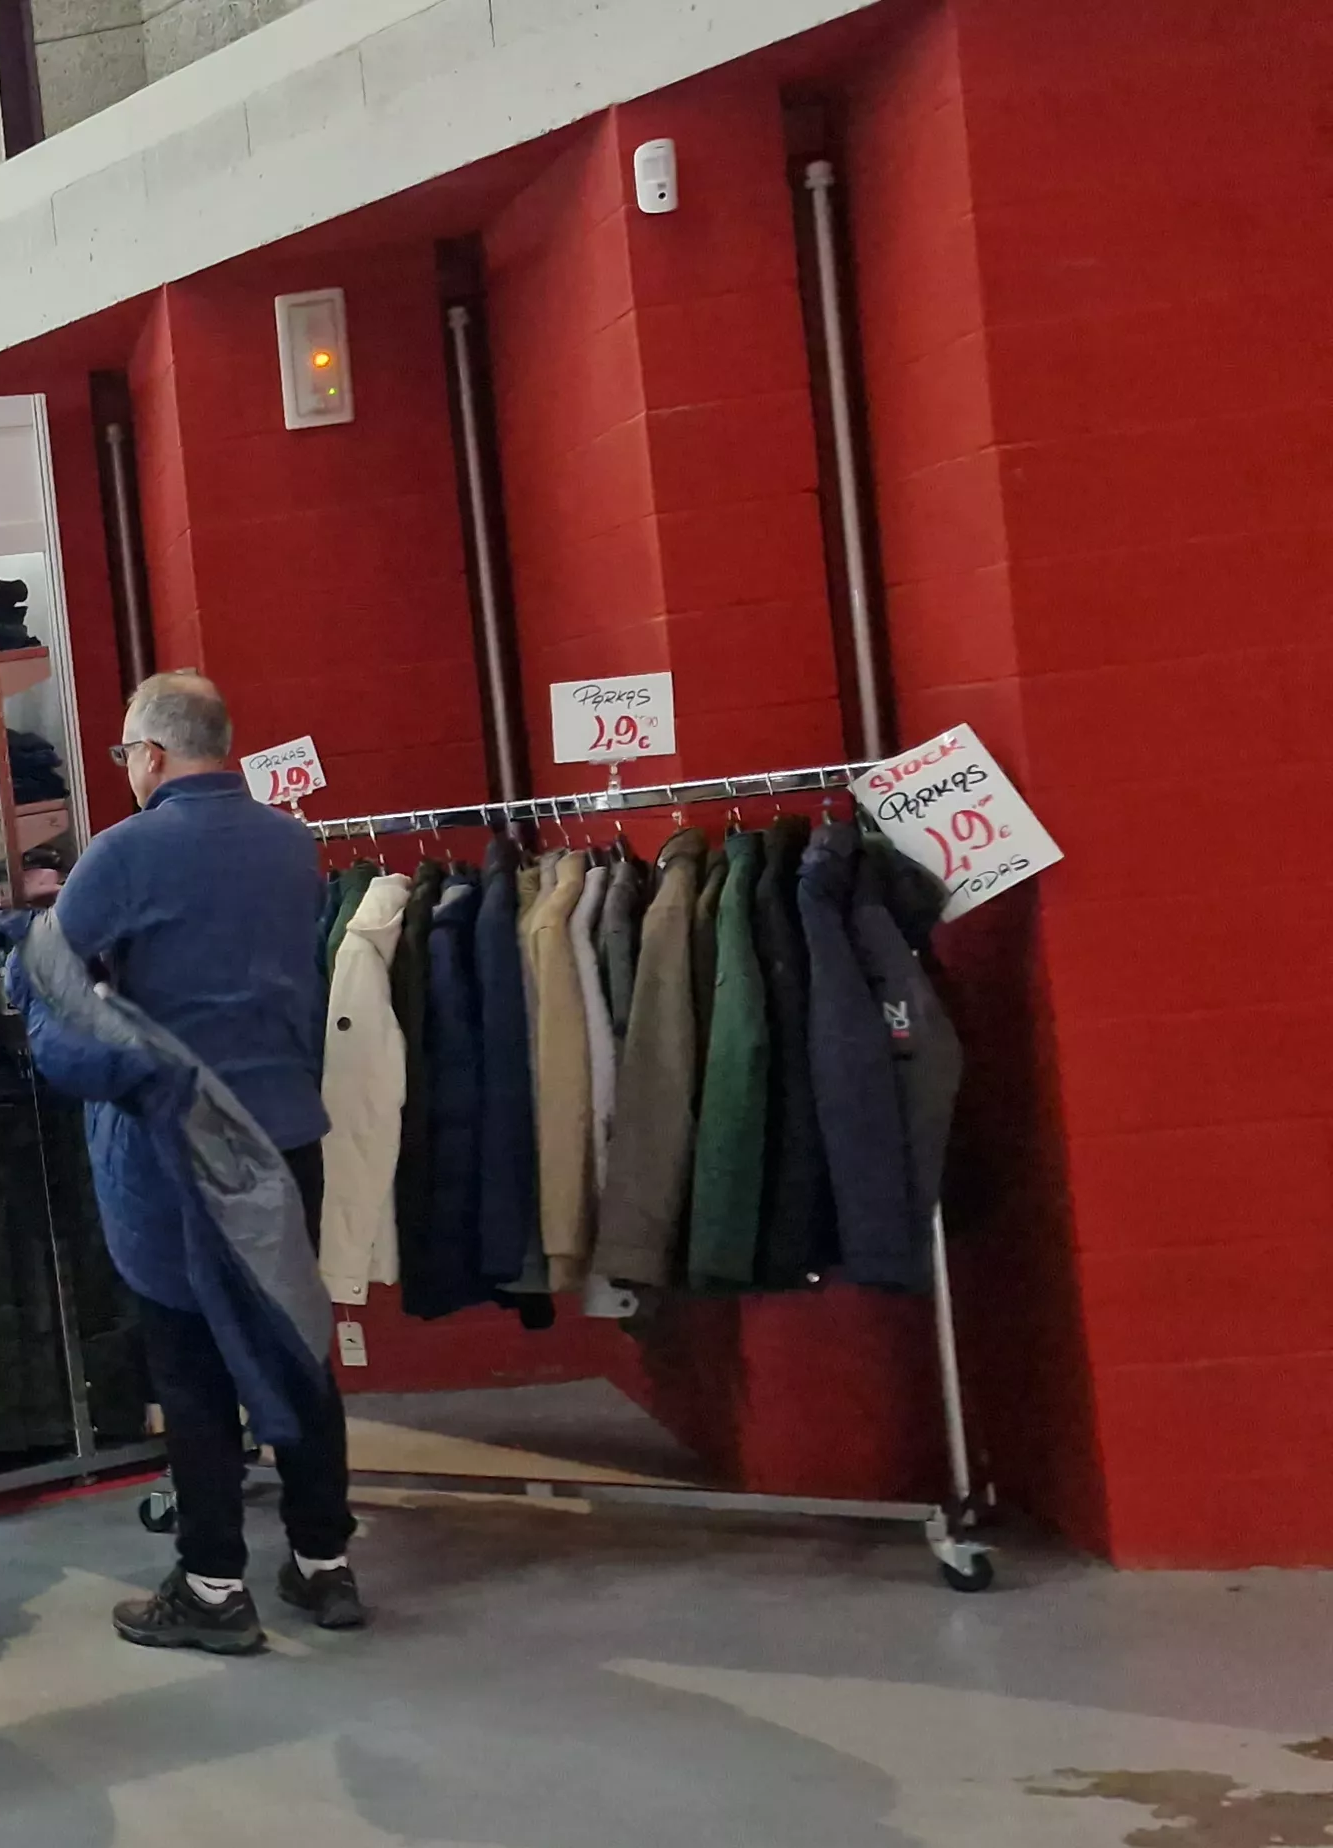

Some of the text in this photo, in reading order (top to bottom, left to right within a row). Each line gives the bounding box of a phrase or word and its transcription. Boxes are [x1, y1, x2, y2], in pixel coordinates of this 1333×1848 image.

[573, 684, 652, 712] PARKAS
[249, 746, 307, 771] PARKAS
[869, 737, 966, 796] STOCK
[878, 763, 988, 824] PARKAS
[950, 853, 1030, 900] TODAS
